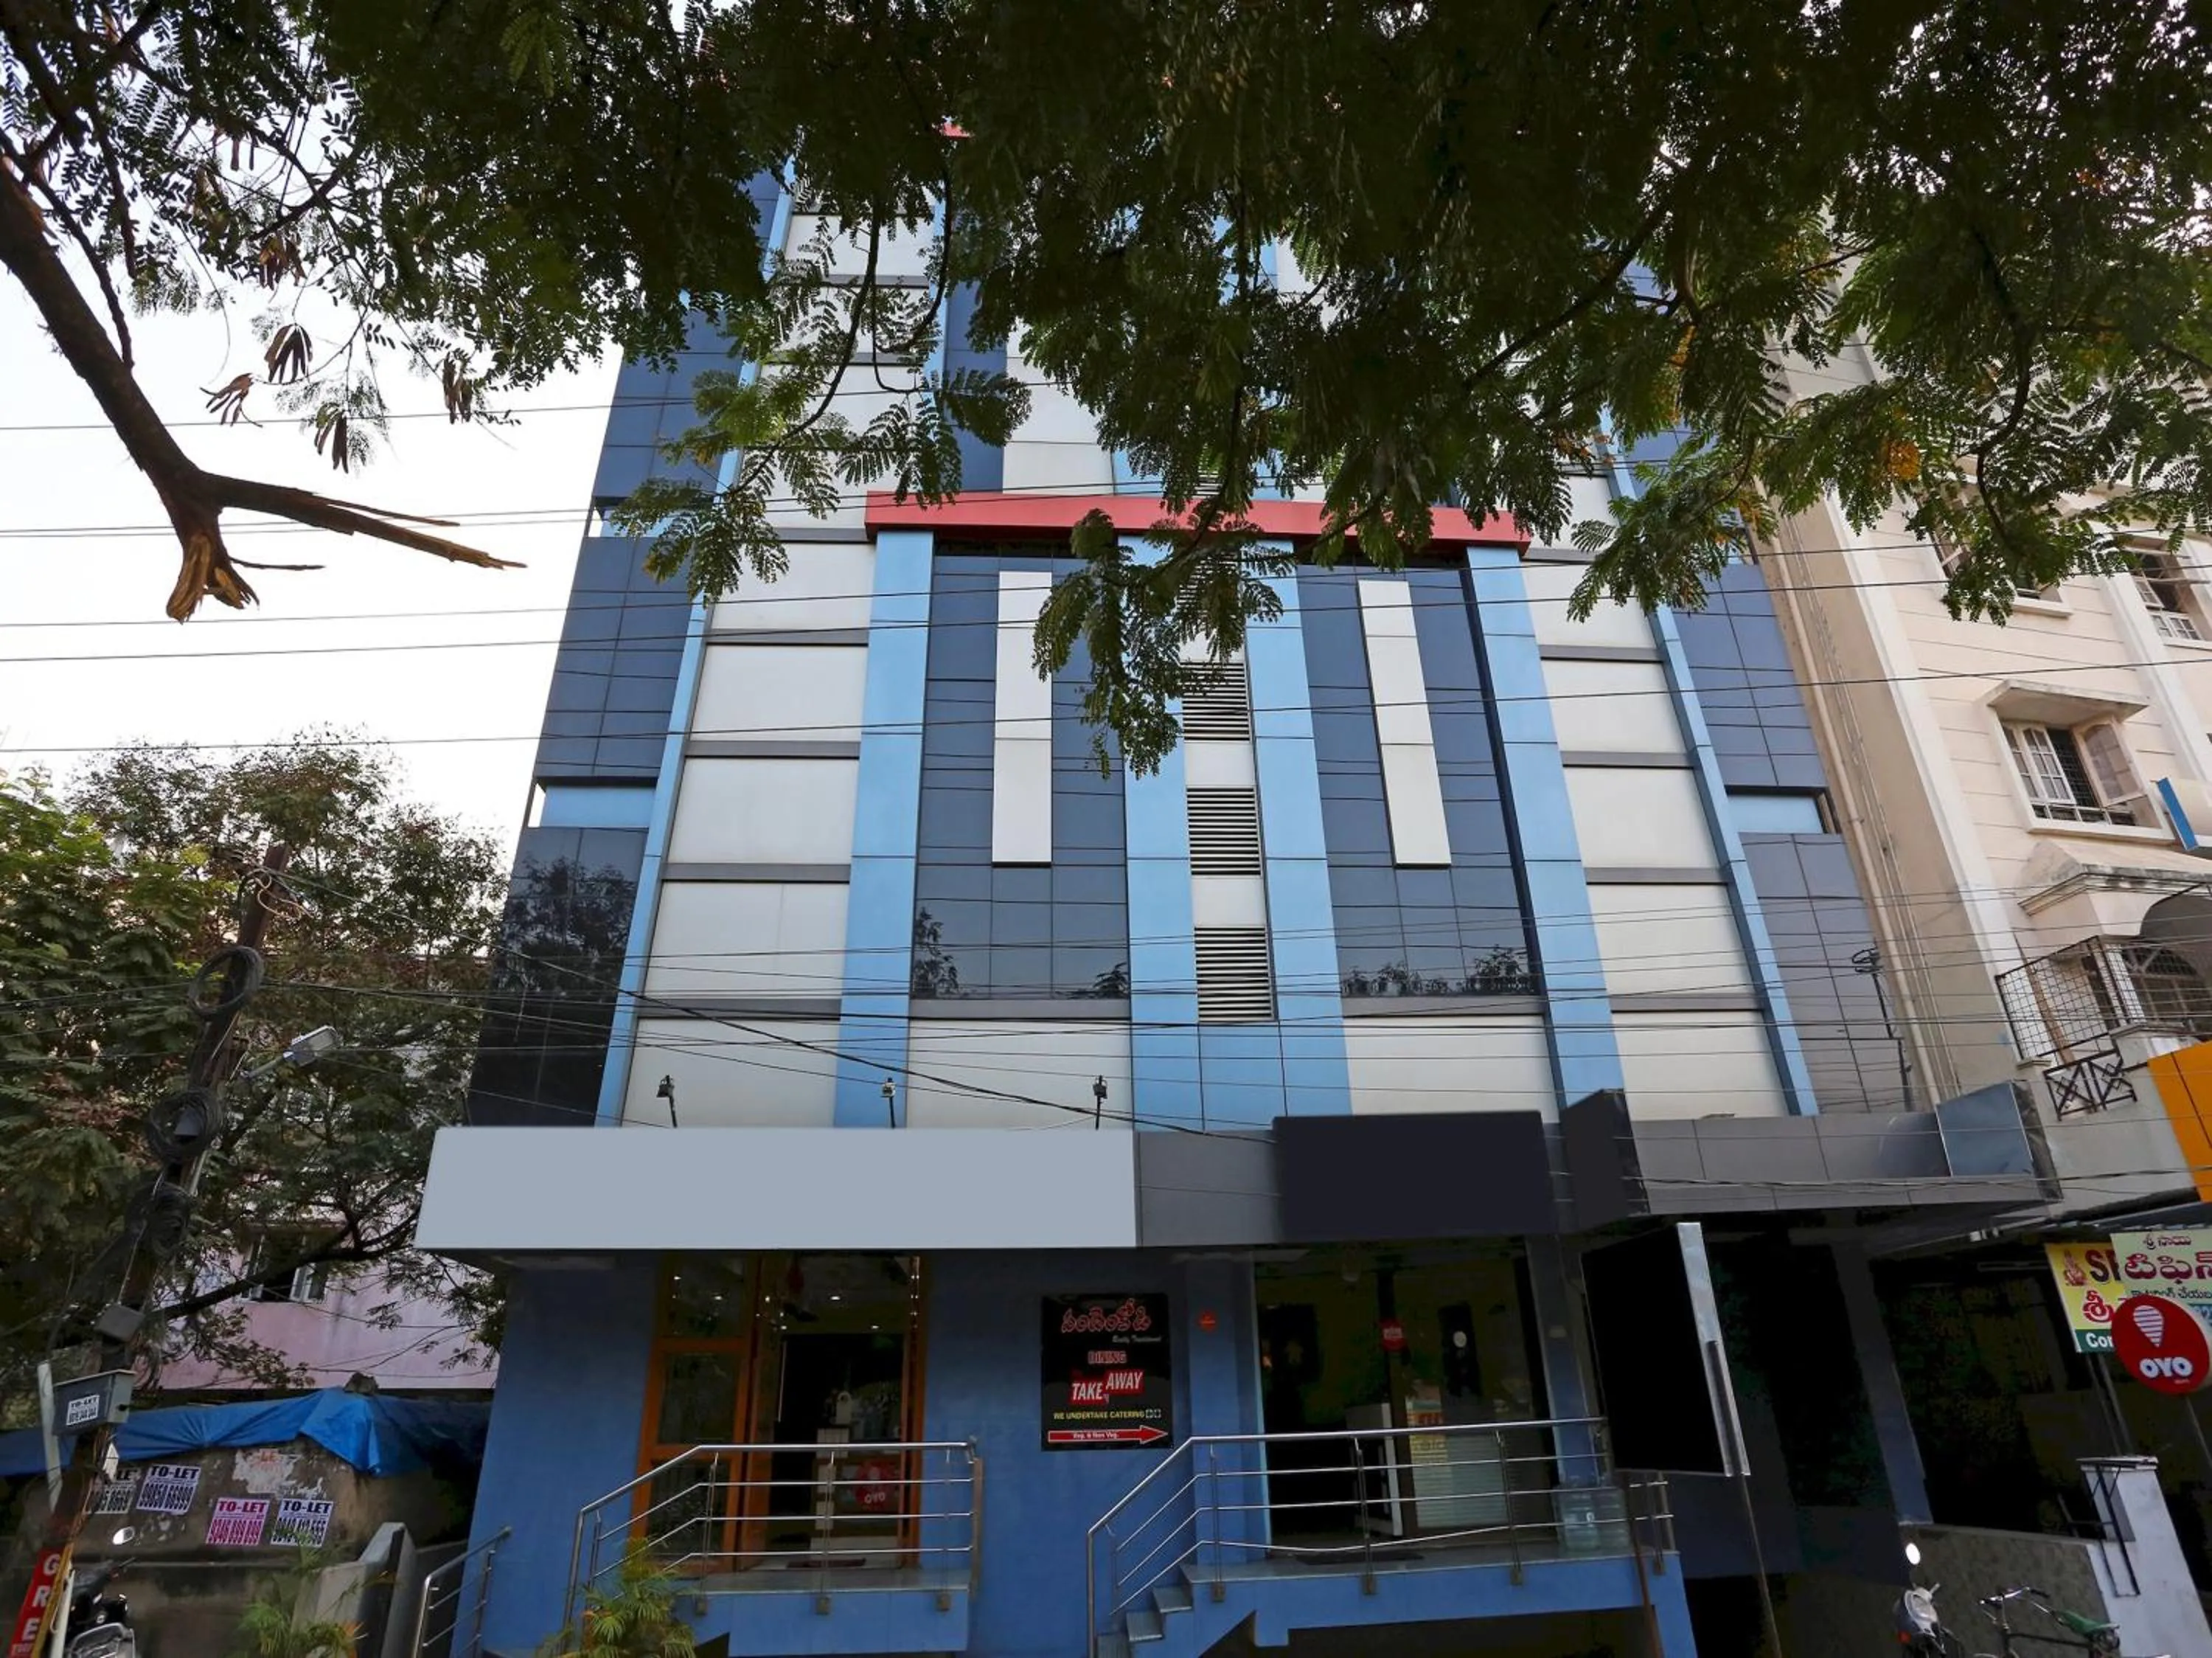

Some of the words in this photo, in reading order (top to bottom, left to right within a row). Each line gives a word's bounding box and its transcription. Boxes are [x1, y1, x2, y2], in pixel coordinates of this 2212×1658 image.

[2139, 1356, 2193, 1378] OYO
[1072, 1382, 1104, 1401] TAKE
[1105, 1372, 1144, 1390] AWAY
[1109, 1410, 1145, 1419] CATERING
[150, 1466, 200, 1480] TO-LET
[218, 1501, 267, 1513] TO-LET
[283, 1500, 333, 1513] TO-LET
